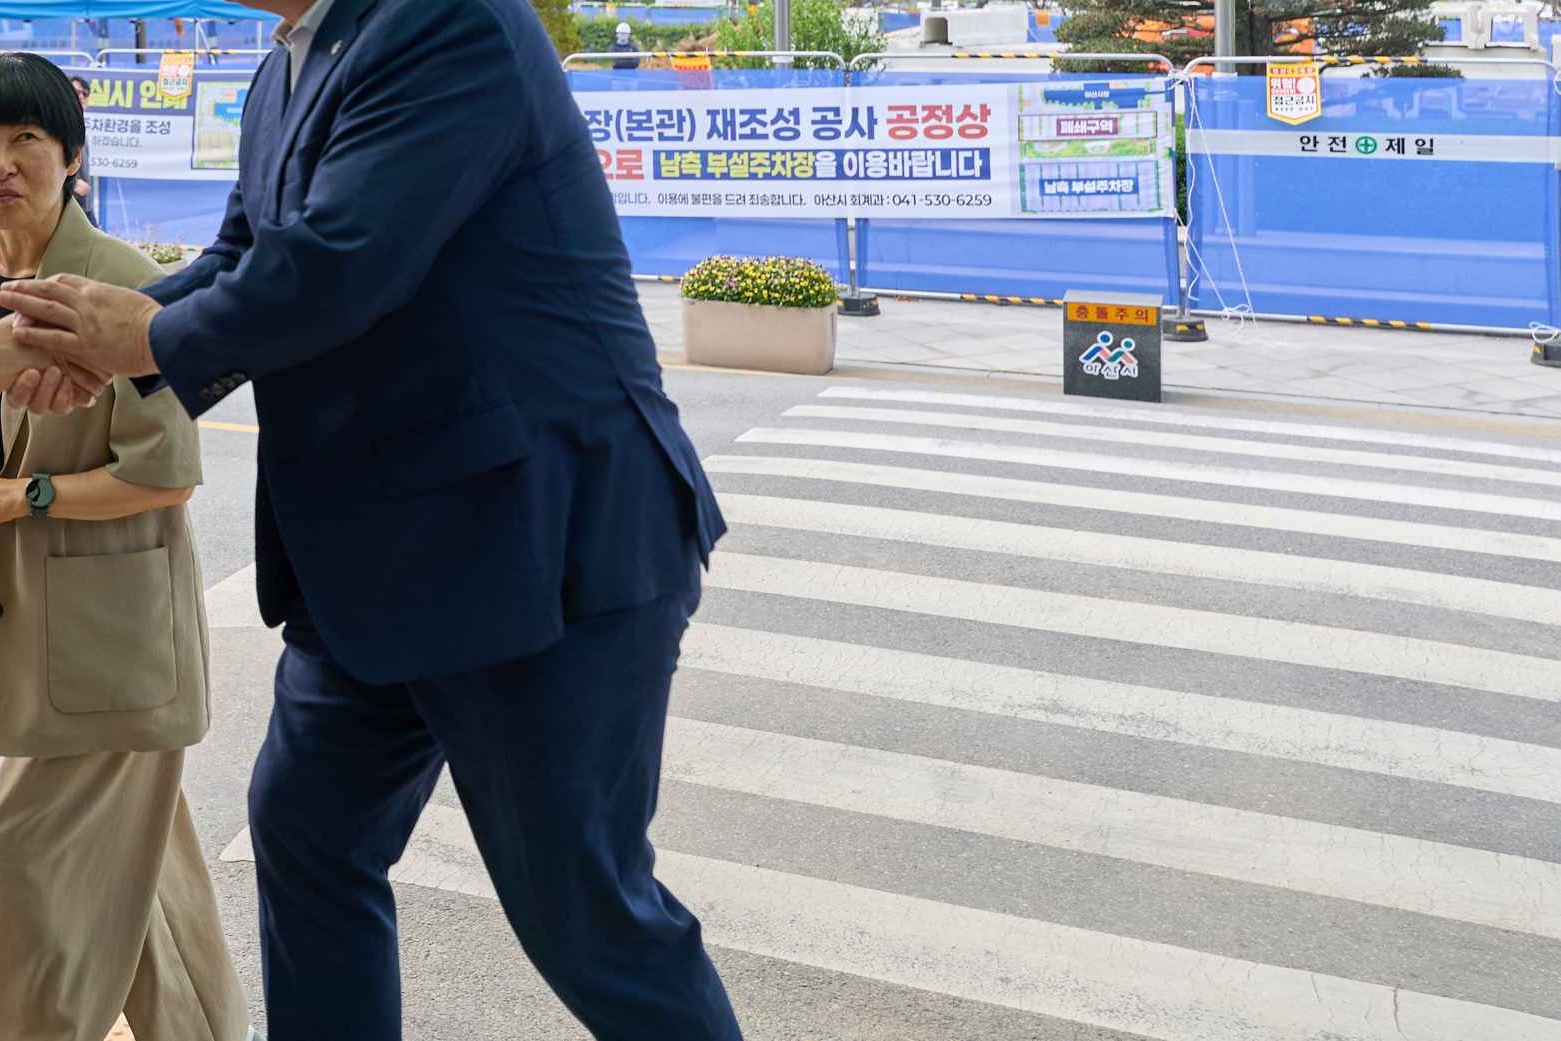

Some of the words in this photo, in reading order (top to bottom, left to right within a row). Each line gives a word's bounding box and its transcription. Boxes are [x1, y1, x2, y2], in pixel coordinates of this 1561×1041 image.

[706, 107, 801, 142] 재조성
[811, 106, 878, 141] 공사
[886, 103, 992, 141] 공정상
[659, 151, 702, 178] 남측
[707, 150, 837, 179] 부설주차장을
[843, 149, 983, 178] 이용바랍니다
[657, 192, 689, 206] 이용에
[725, 192, 746, 206] 드려
[814, 193, 847, 207] 아산시
